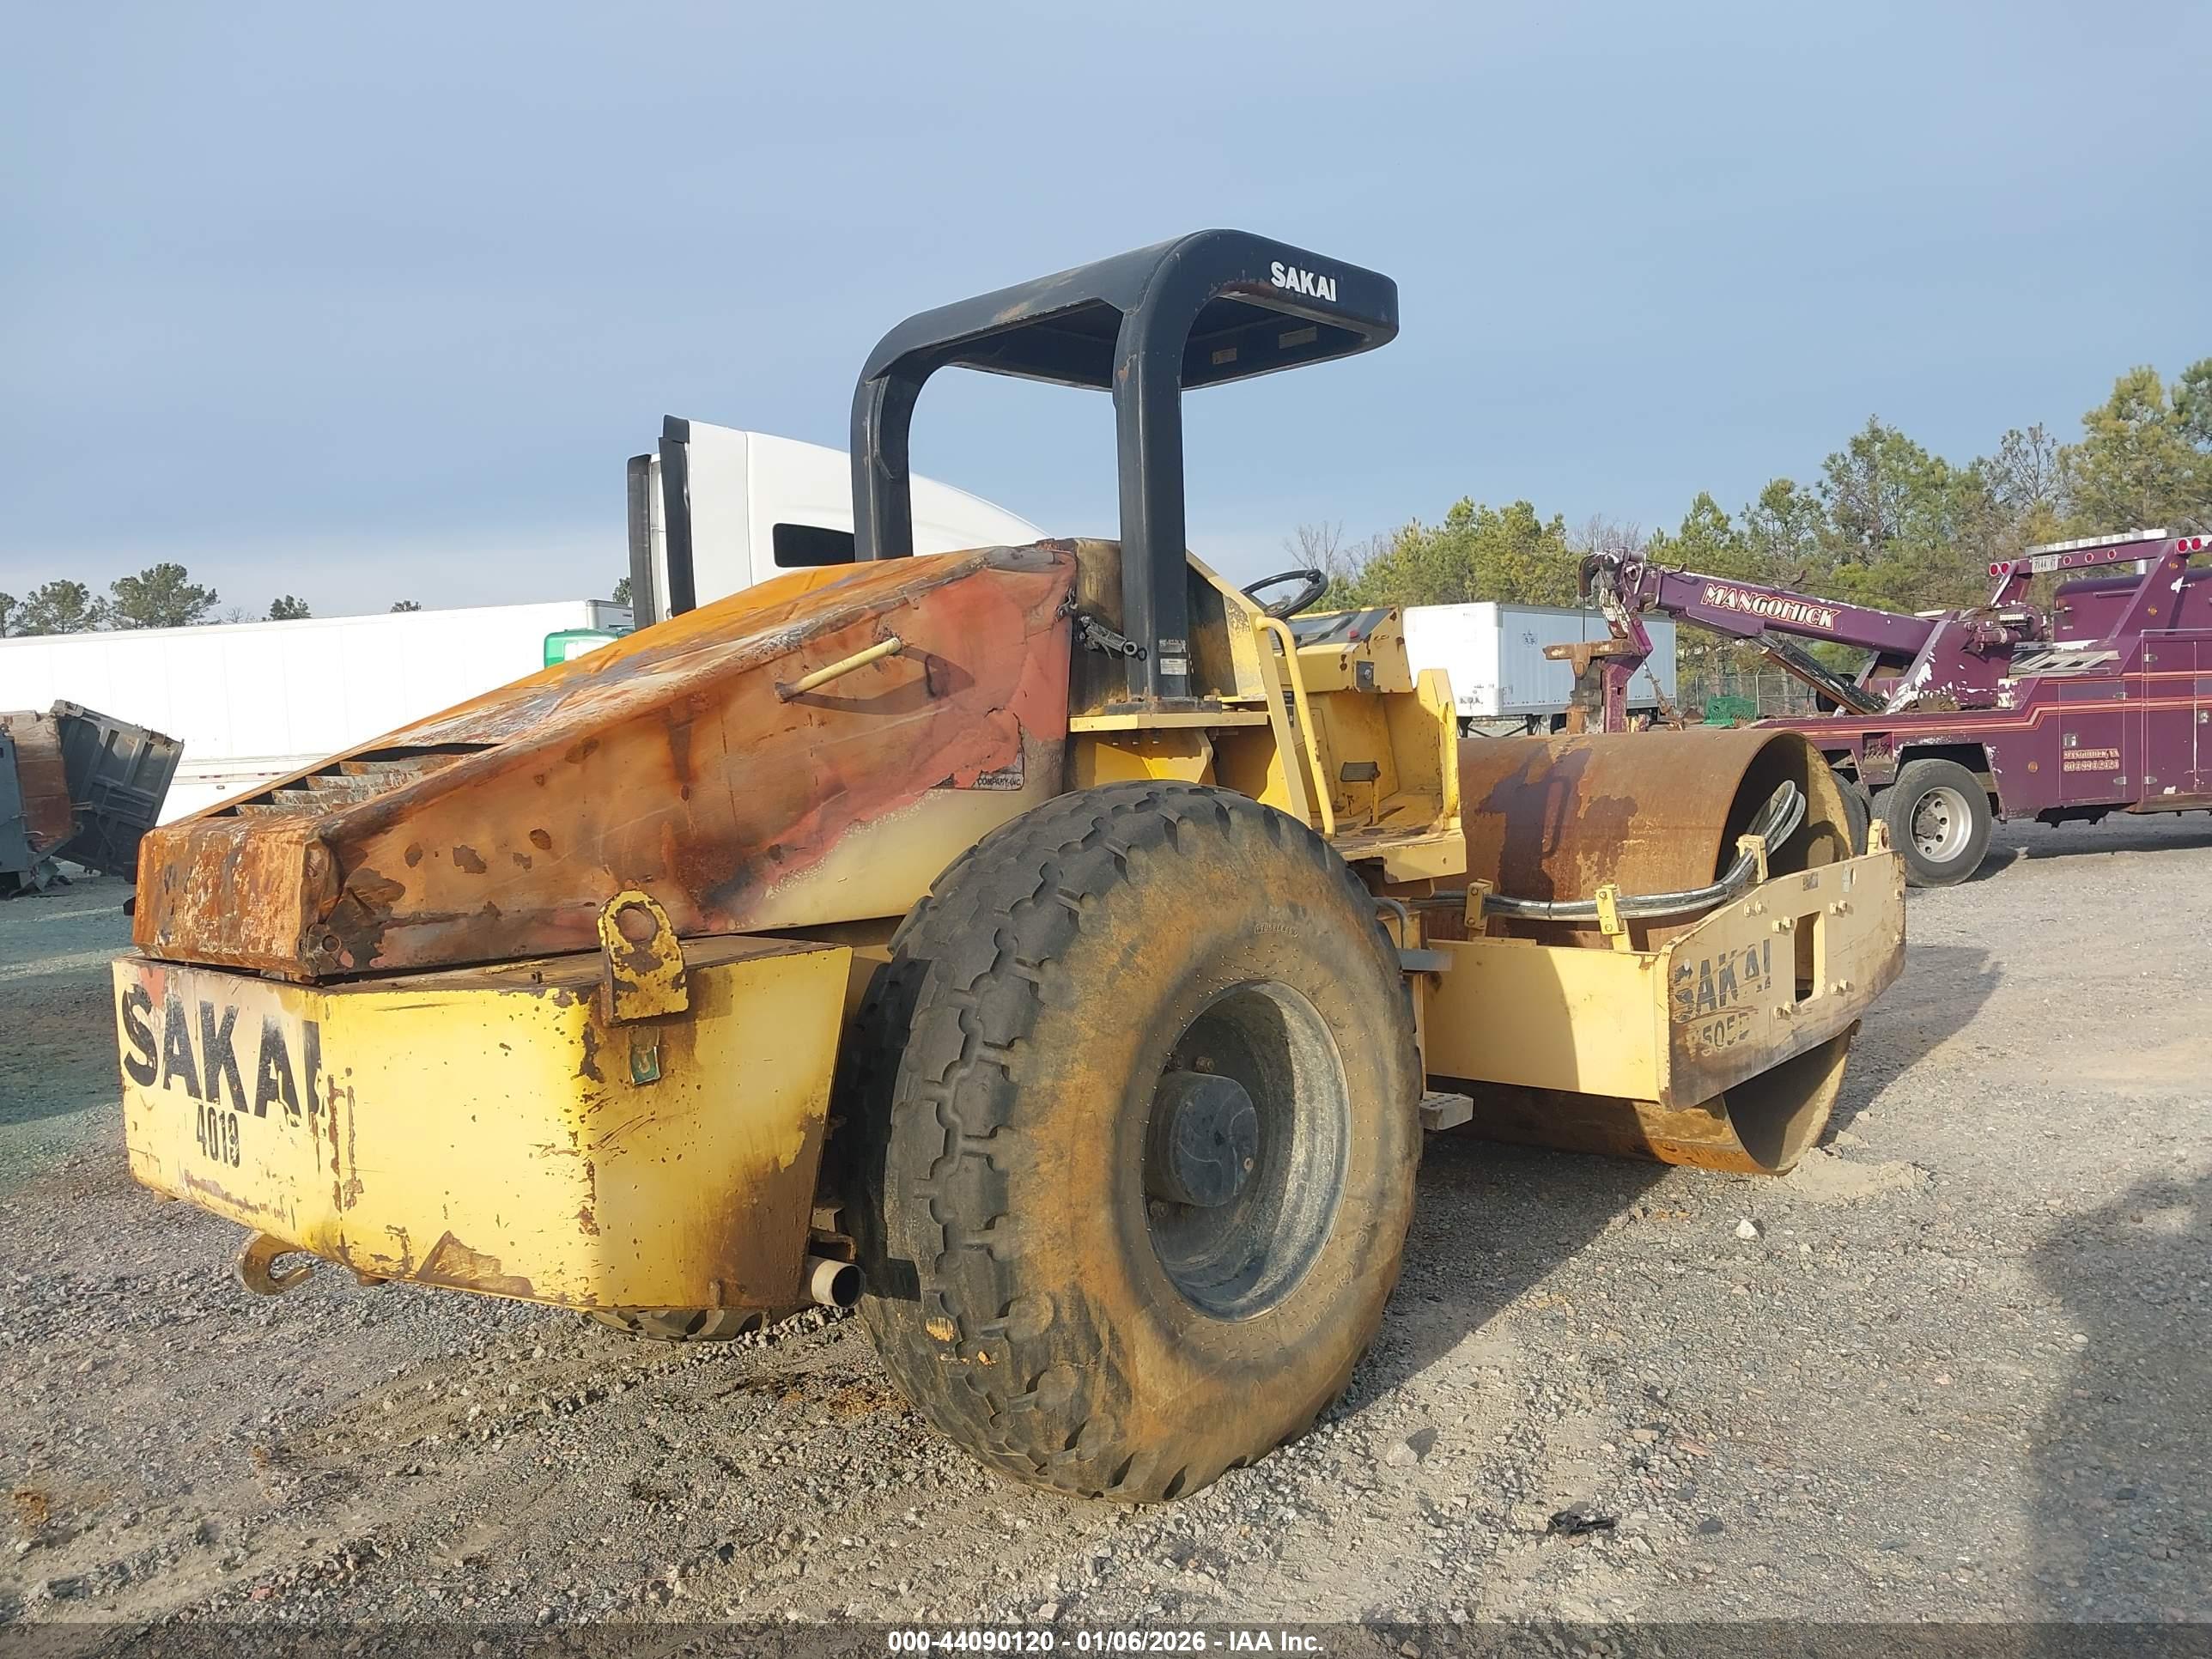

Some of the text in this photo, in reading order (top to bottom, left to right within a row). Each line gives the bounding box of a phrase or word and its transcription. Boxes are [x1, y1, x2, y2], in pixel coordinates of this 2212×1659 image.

[1270, 261, 1337, 301] SAKAI
[1701, 584, 1841, 630] MANGOHICK
[1674, 939, 1771, 1022] SAKAI
[122, 983, 325, 1119] SAKAI
[196, 1104, 240, 1168] 4019
